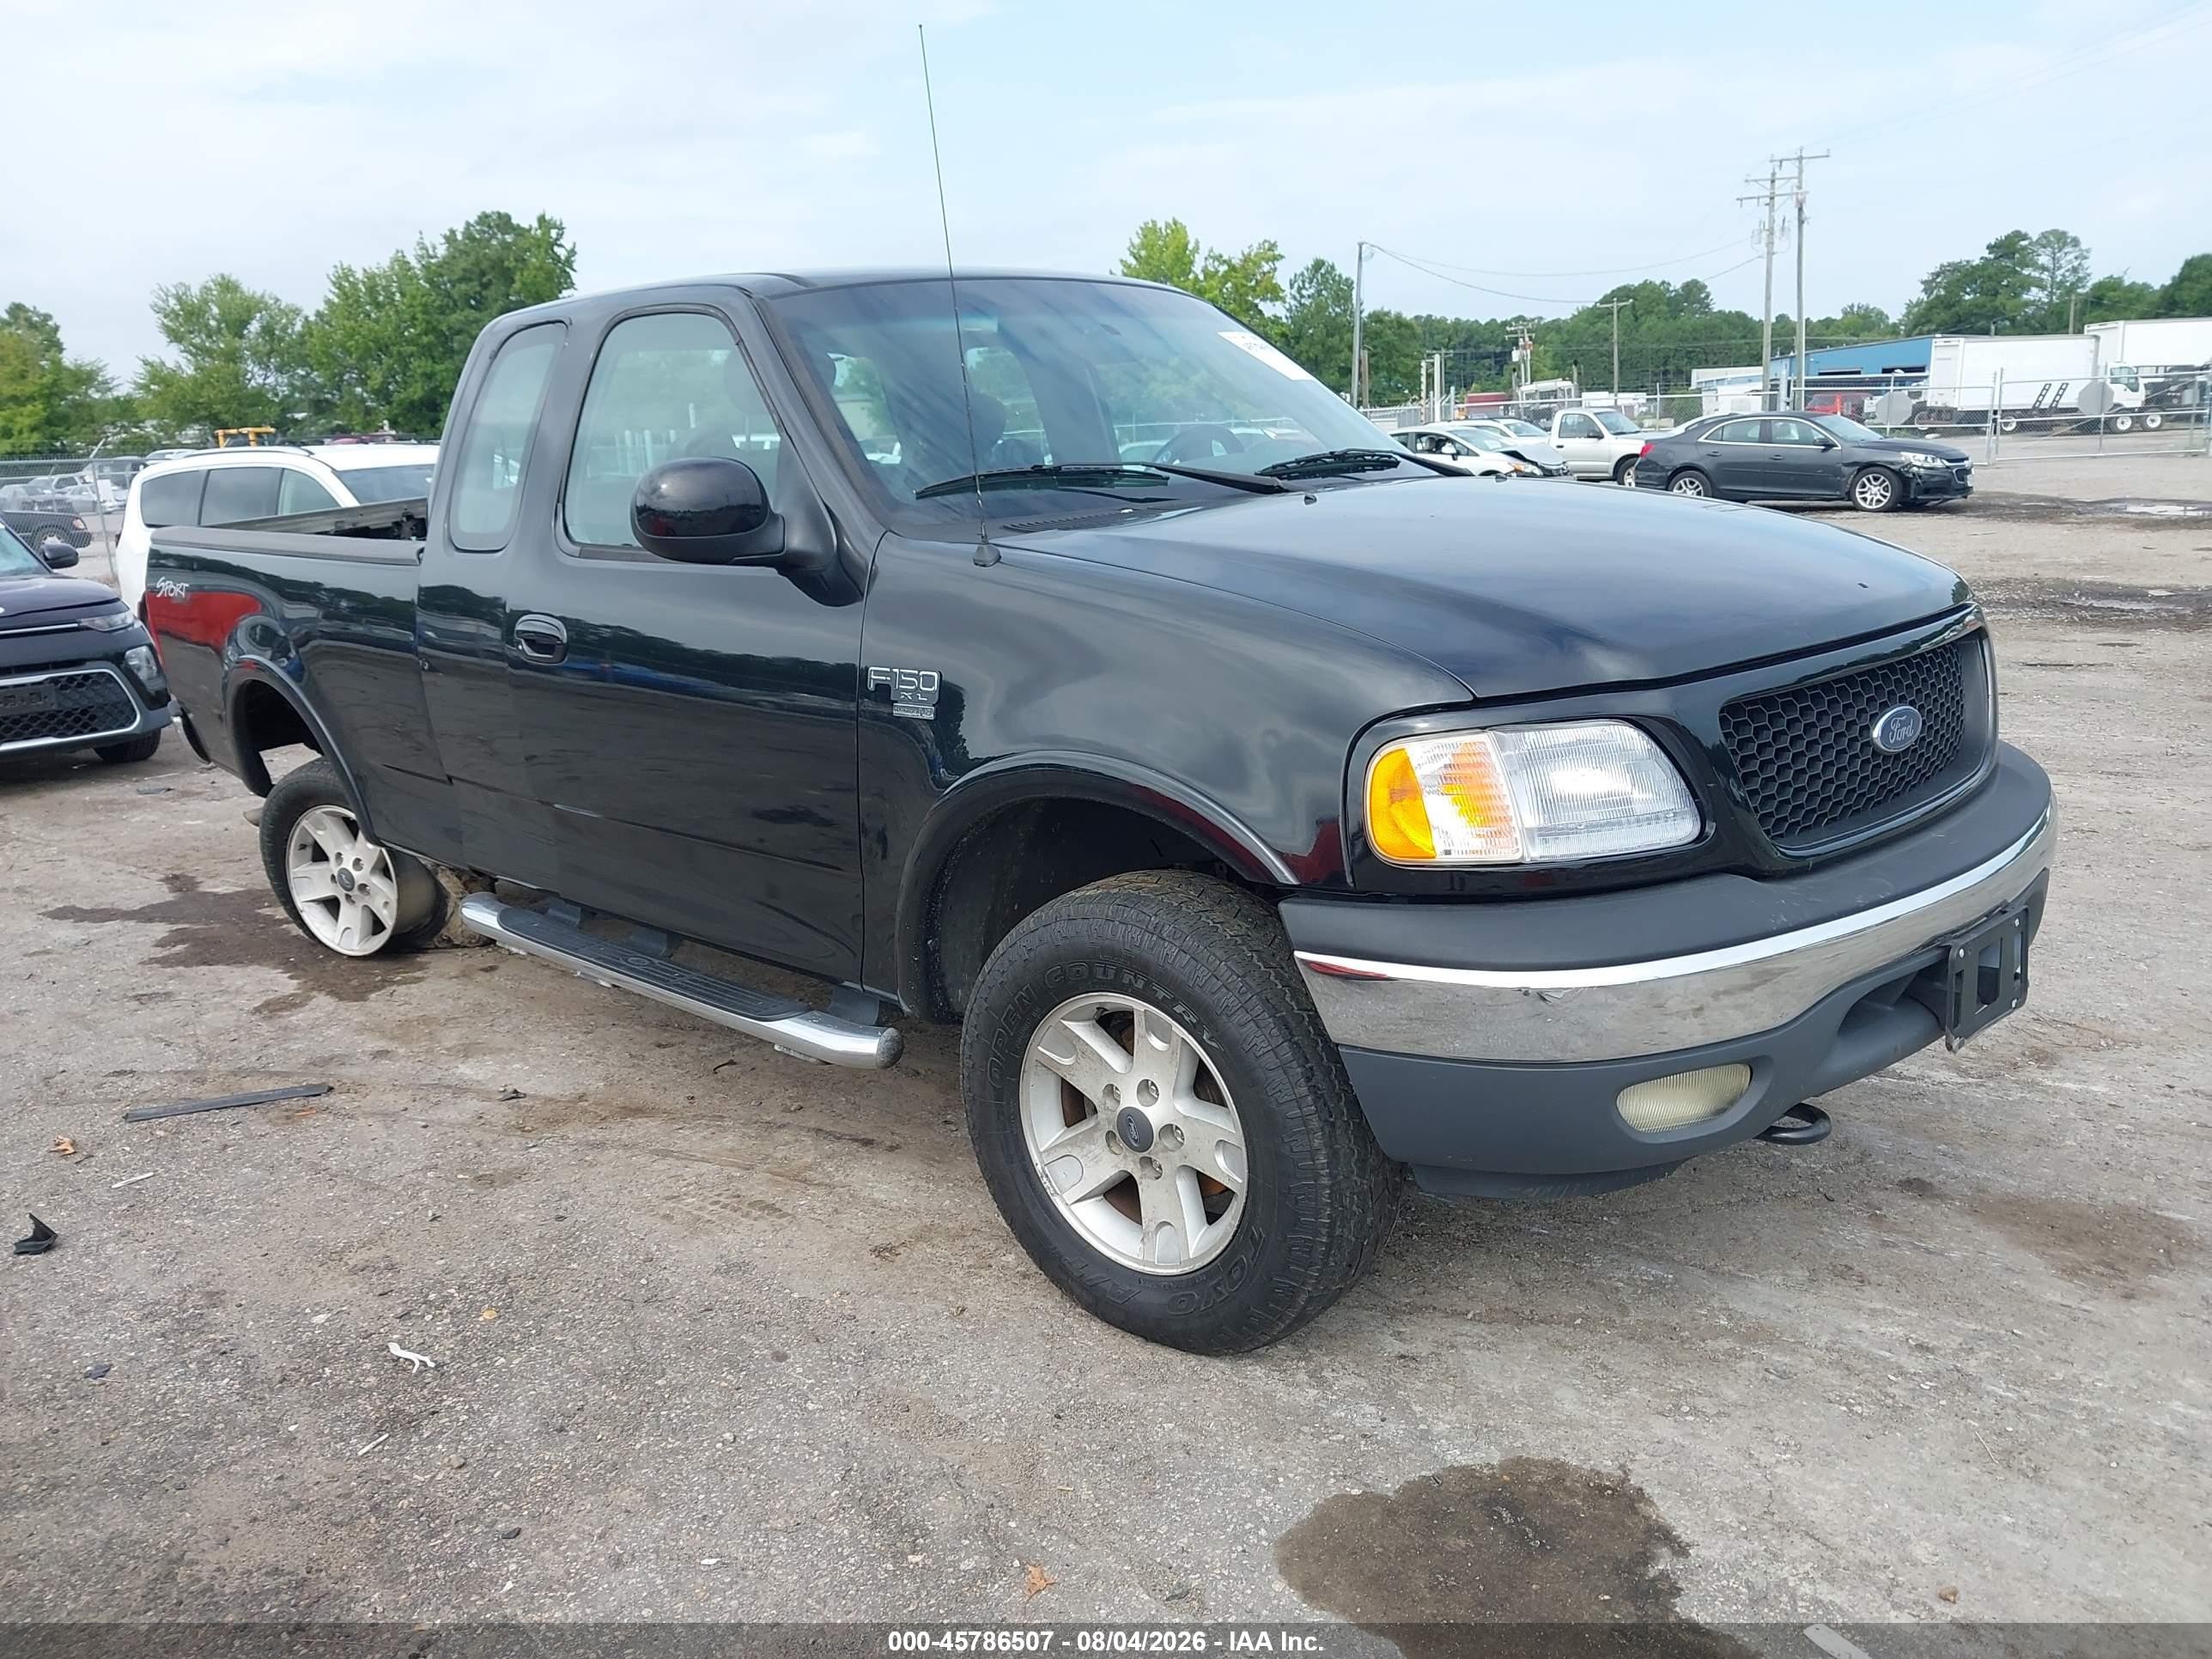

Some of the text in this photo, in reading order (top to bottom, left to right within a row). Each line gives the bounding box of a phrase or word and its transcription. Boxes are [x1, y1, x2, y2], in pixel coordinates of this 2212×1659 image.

[156, 576, 189, 599] SPORT
[1889, 715, 1914, 744] Ford
[987, 983, 1038, 1089] OPEN
[1044, 961, 1225, 1053] COUNTRY
